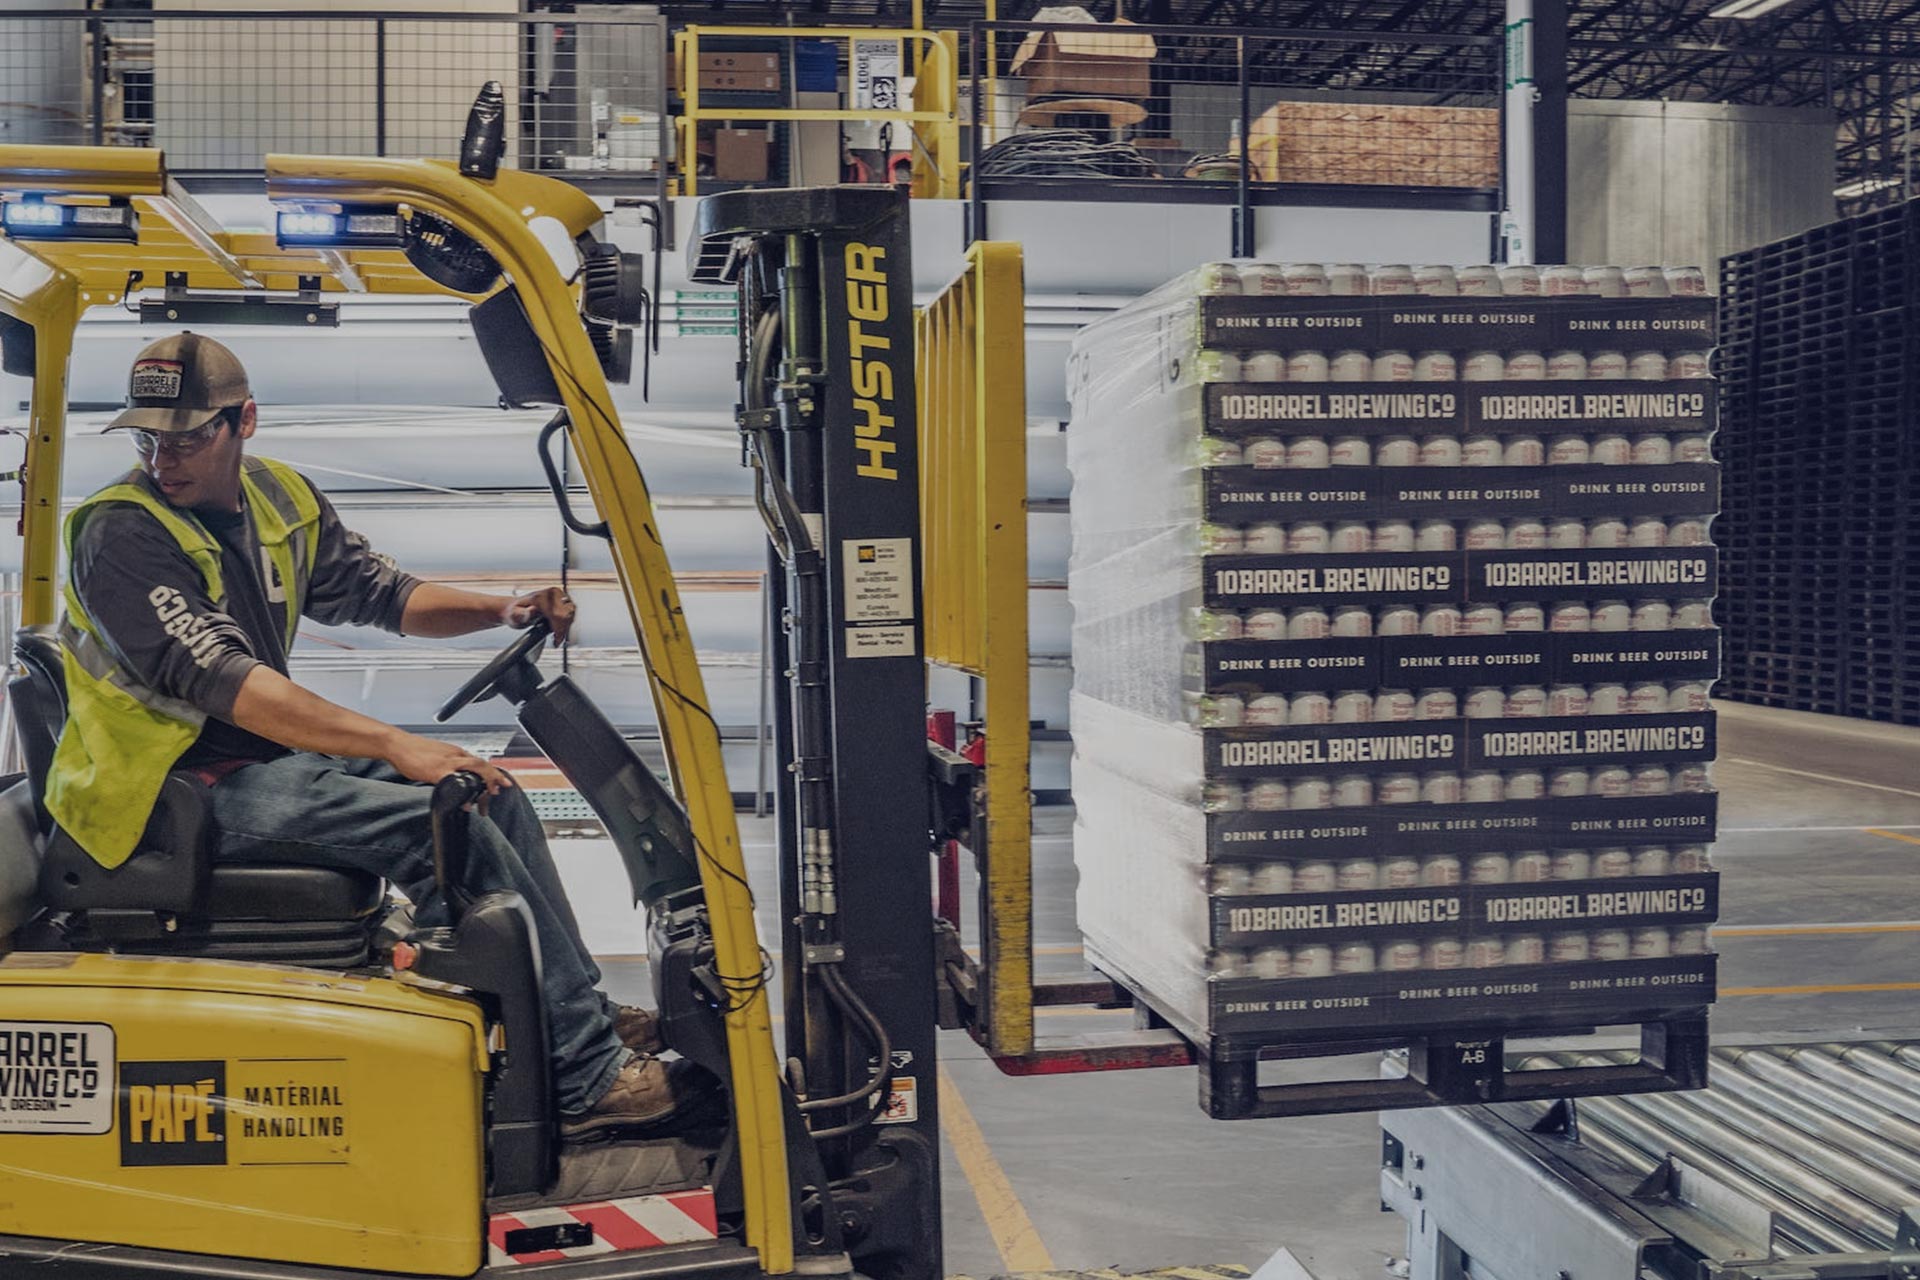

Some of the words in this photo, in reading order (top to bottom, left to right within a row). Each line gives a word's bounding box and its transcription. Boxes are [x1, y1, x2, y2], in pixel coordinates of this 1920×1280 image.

[1216, 318, 1260, 327] DRINK
[1267, 318, 1298, 327] BEER
[1305, 318, 1361, 327] OUTSIDE
[1394, 314, 1436, 323] DRINK
[1443, 314, 1473, 323] BEER
[1480, 314, 1534, 323] OUTSIDE
[1570, 321, 1610, 329] DRINK
[1617, 320, 1646, 329] BEER
[1652, 319, 1706, 329] OUTSIDE
[845, 242, 898, 480] HYSTER
[1570, 484, 1610, 493] DRINK
[1617, 484, 1645, 493] BEER
[1652, 483, 1705, 492] OUTSIDE
[1221, 493, 1264, 502] DRINK
[1271, 492, 1302, 501] BEER
[1309, 492, 1365, 501] OUTSIDE
[1399, 491, 1441, 500] DRINK
[1448, 490, 1478, 499] BEER
[1485, 490, 1539, 499] OUTSIDE
[1400, 657, 1442, 667] DRINK
[1448, 656, 1479, 665] BEER
[1485, 654, 1540, 664] OUTSIDE
[1573, 653, 1613, 662] DRINK
[1620, 652, 1649, 661] BEER
[1655, 650, 1708, 661] OUTSIDE
[1220, 660, 1263, 670] DRINK
[1270, 659, 1301, 668] BEER
[1307, 657, 1364, 667] OUTSIDE
[1398, 822, 1440, 831] DRINK
[1446, 820, 1476, 829] BEER
[1482, 817, 1537, 828] OUTSIDE
[1571, 820, 1611, 830] DRINK
[1618, 819, 1647, 828] BEER
[1653, 816, 1705, 827] OUTSIDE
[1223, 831, 1267, 841] DRINK
[1273, 830, 1304, 839] BEER
[1311, 827, 1366, 838] OUTSIDE
[1570, 979, 1610, 989] DRINK
[1616, 977, 1645, 987] BEER
[1651, 974, 1703, 985] OUTSIDE
[1399, 989, 1441, 999] DRINK
[1447, 987, 1477, 996] BEER
[1483, 983, 1538, 995] OUTSIDE
[1226, 1002, 1269, 1013] DRINK
[1275, 1000, 1307, 1010] BEER
[1313, 997, 1369, 1008] OUTSIDE
[1461, 1050, 1485, 1064] A-B
[244, 1117, 343, 1137] HANDLING
